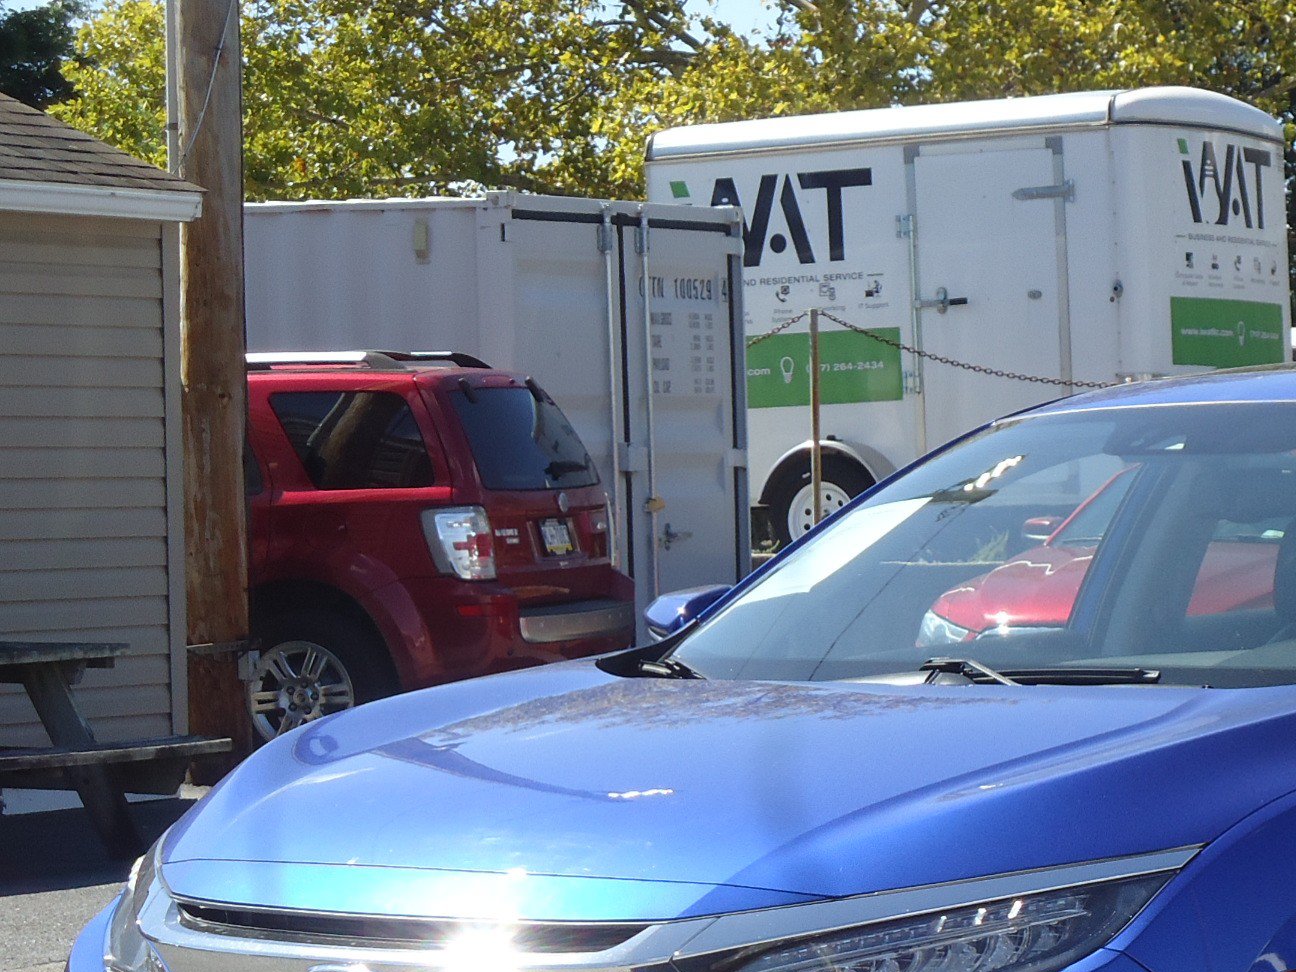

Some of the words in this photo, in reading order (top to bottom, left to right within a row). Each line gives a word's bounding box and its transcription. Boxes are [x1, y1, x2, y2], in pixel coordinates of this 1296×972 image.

[759, 275, 820, 286] RESIDENTIAL
[823, 271, 864, 282] SERVICE
[674, 278, 712, 300] 100529
[833, 360, 884, 372] 264-2434
